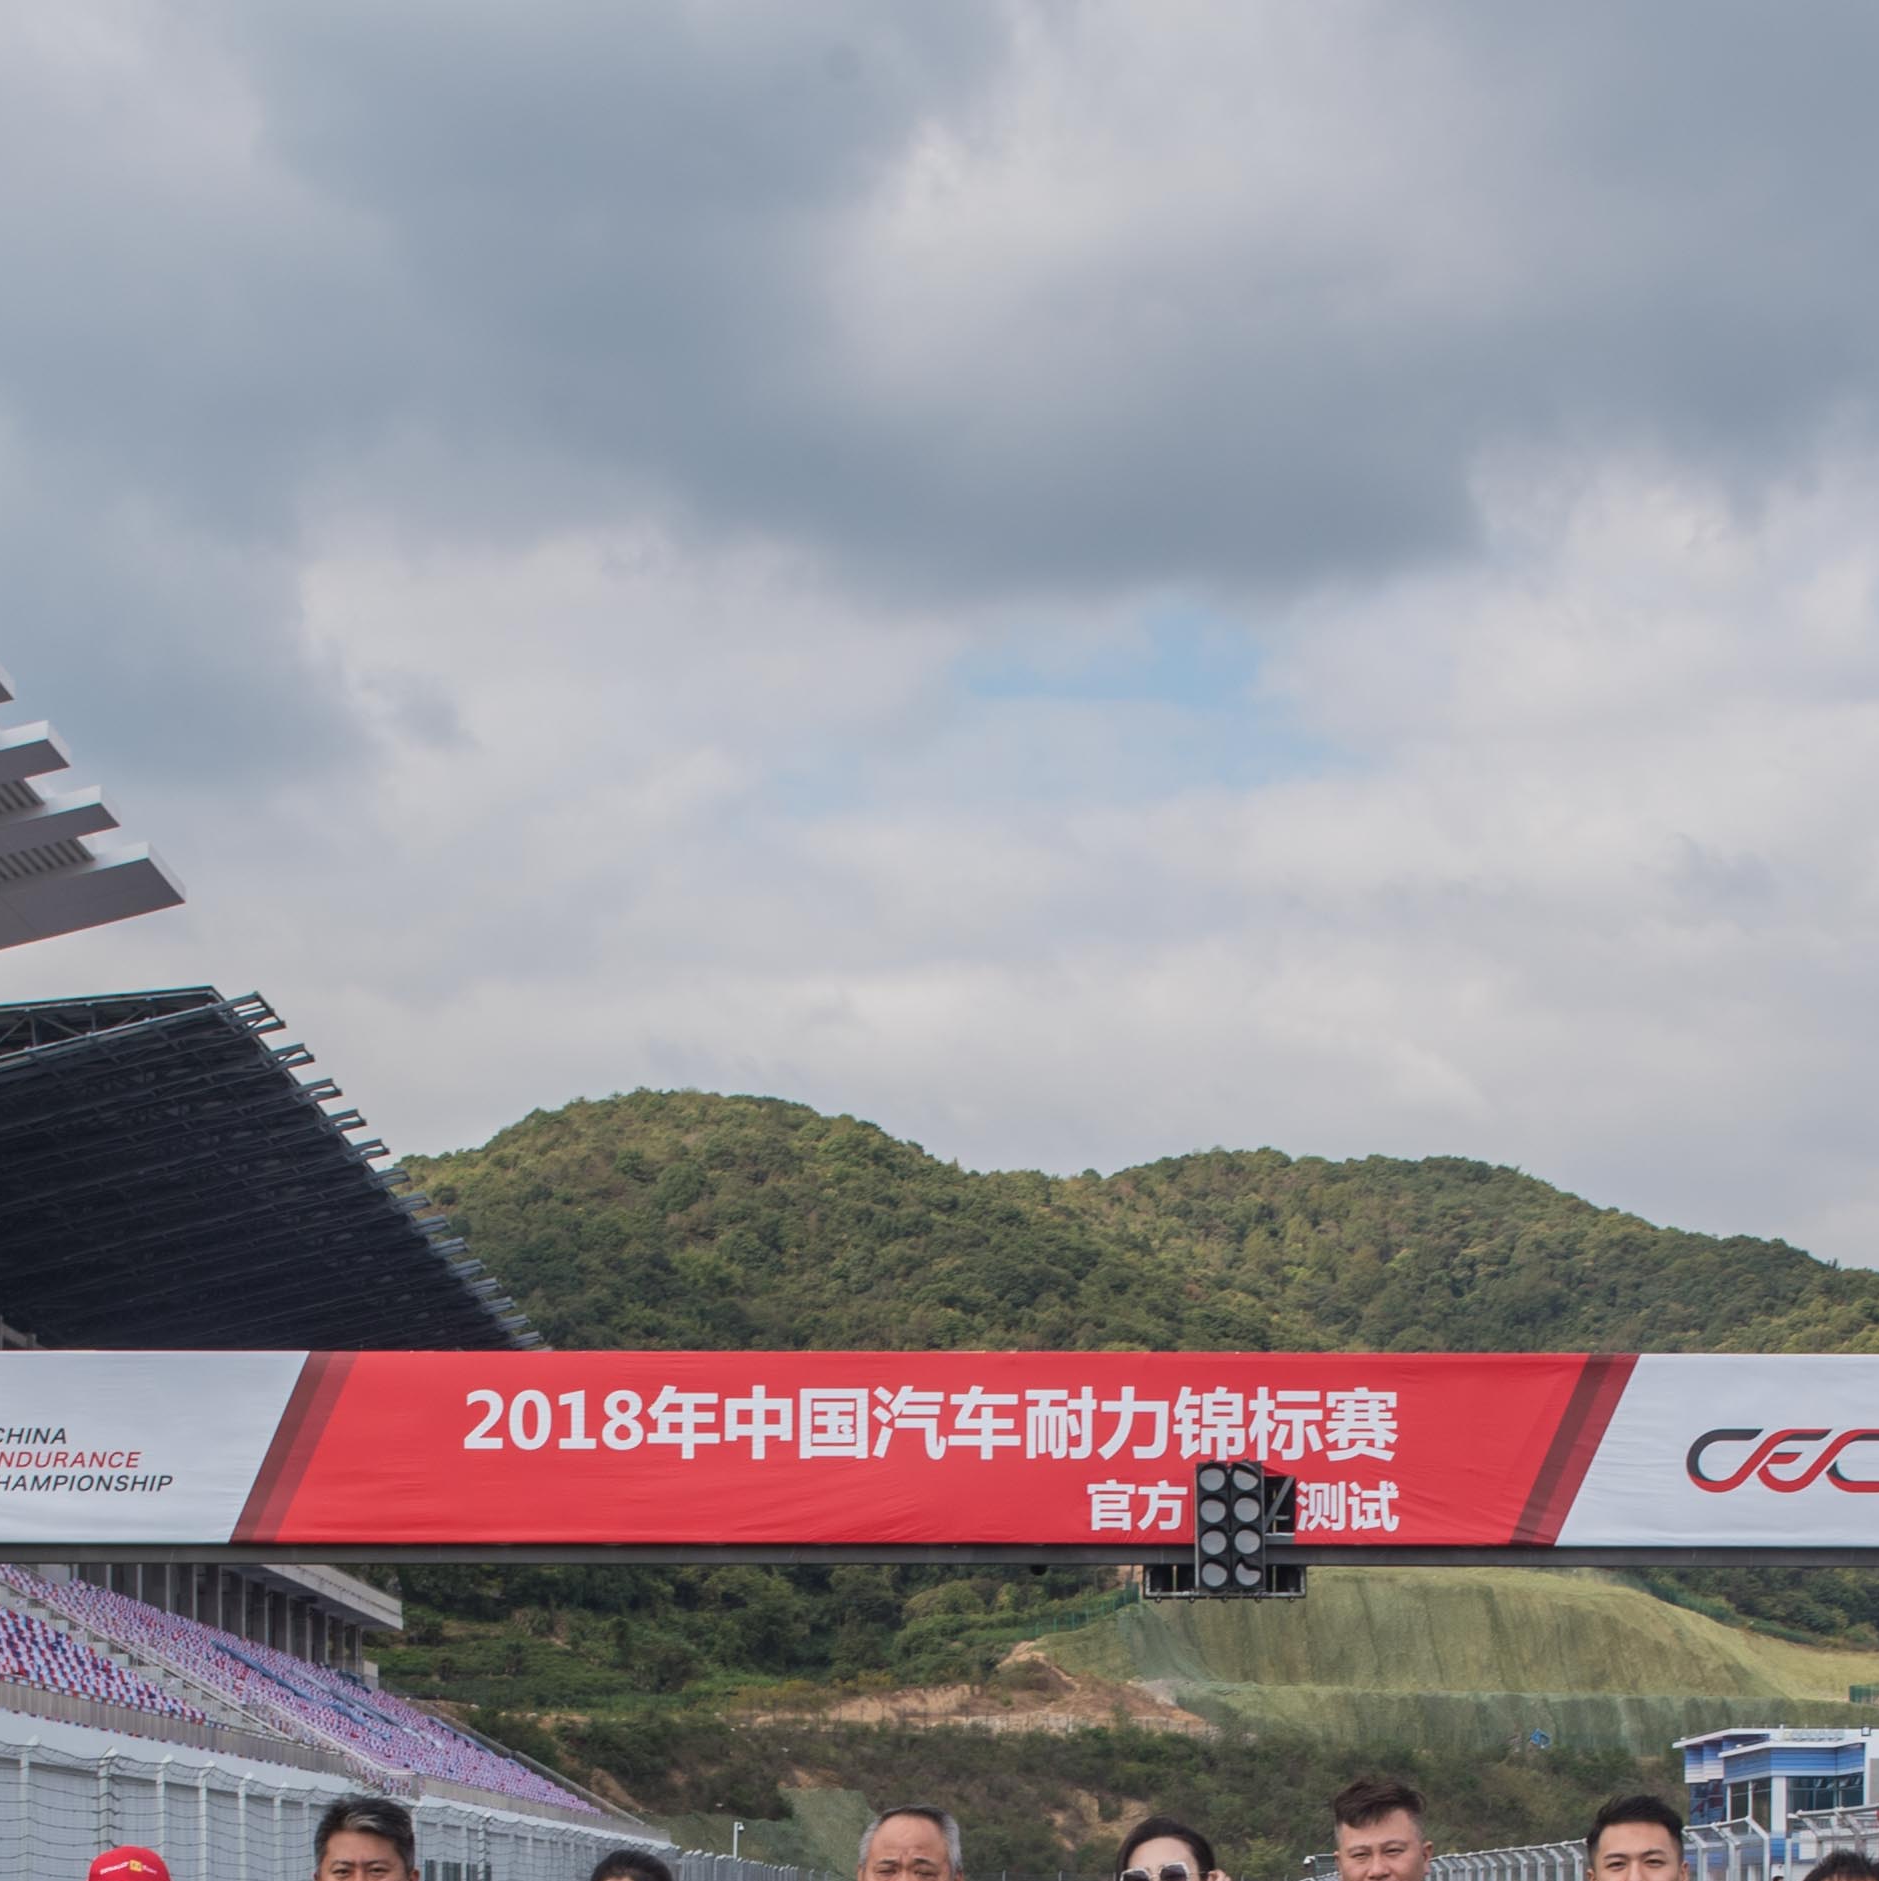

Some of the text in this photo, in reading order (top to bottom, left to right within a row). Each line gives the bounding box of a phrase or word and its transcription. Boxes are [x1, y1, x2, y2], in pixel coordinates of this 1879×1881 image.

[463, 1386, 1398, 1461] 2018年中国汽车耐力锦标赛
[1087, 1482, 1400, 1532] 官方 测试
